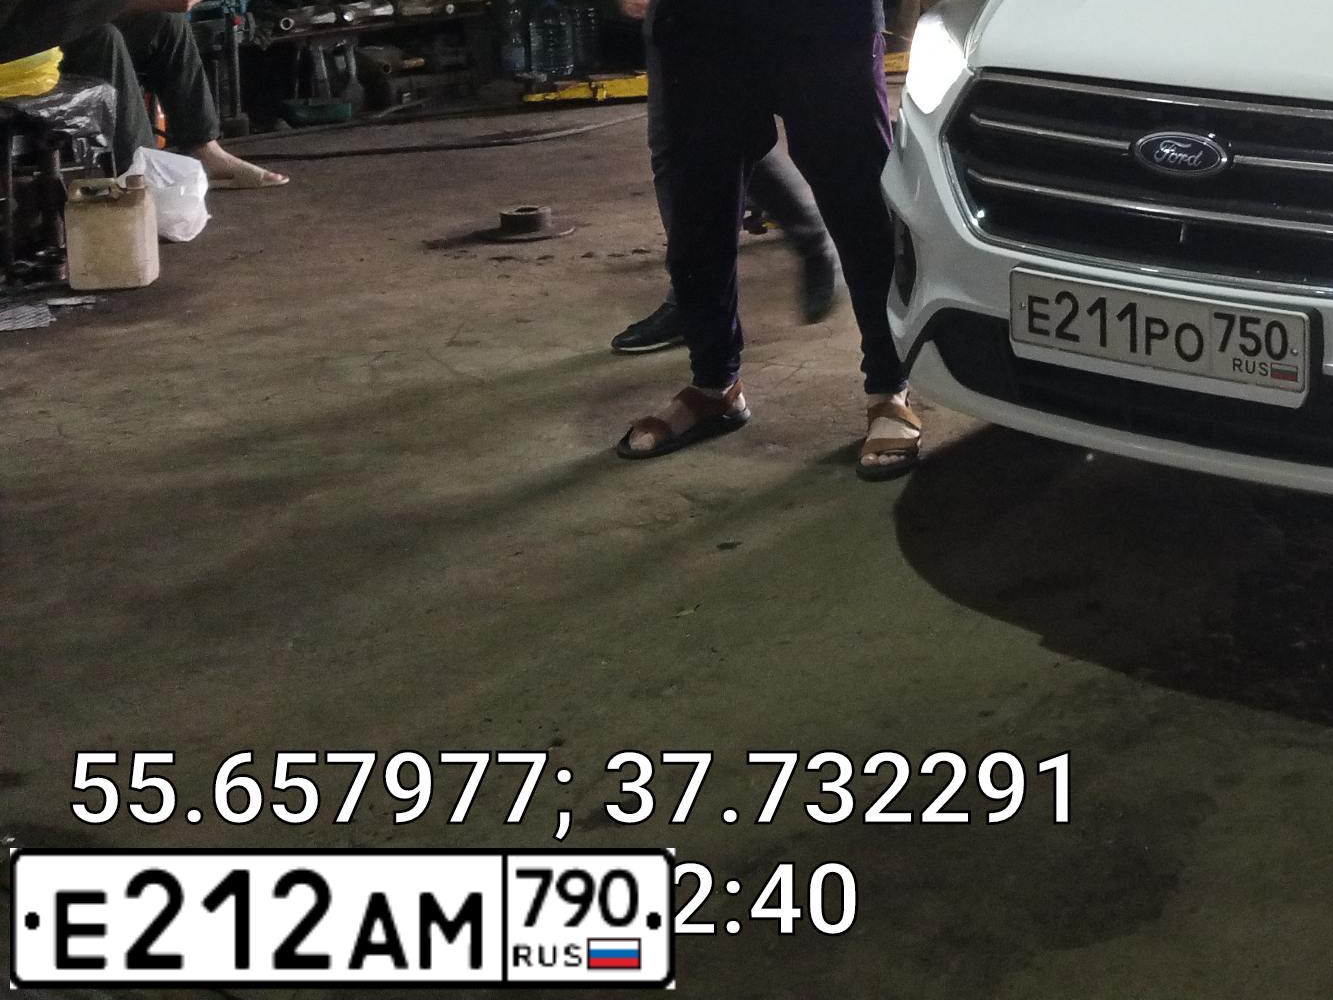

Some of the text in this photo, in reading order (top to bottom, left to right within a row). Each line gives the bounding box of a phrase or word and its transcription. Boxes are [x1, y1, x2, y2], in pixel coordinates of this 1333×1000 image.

[1153, 139, 1204, 168] Ford
[1213, 312, 1289, 361] 750
[1232, 357, 1269, 377] RUS
